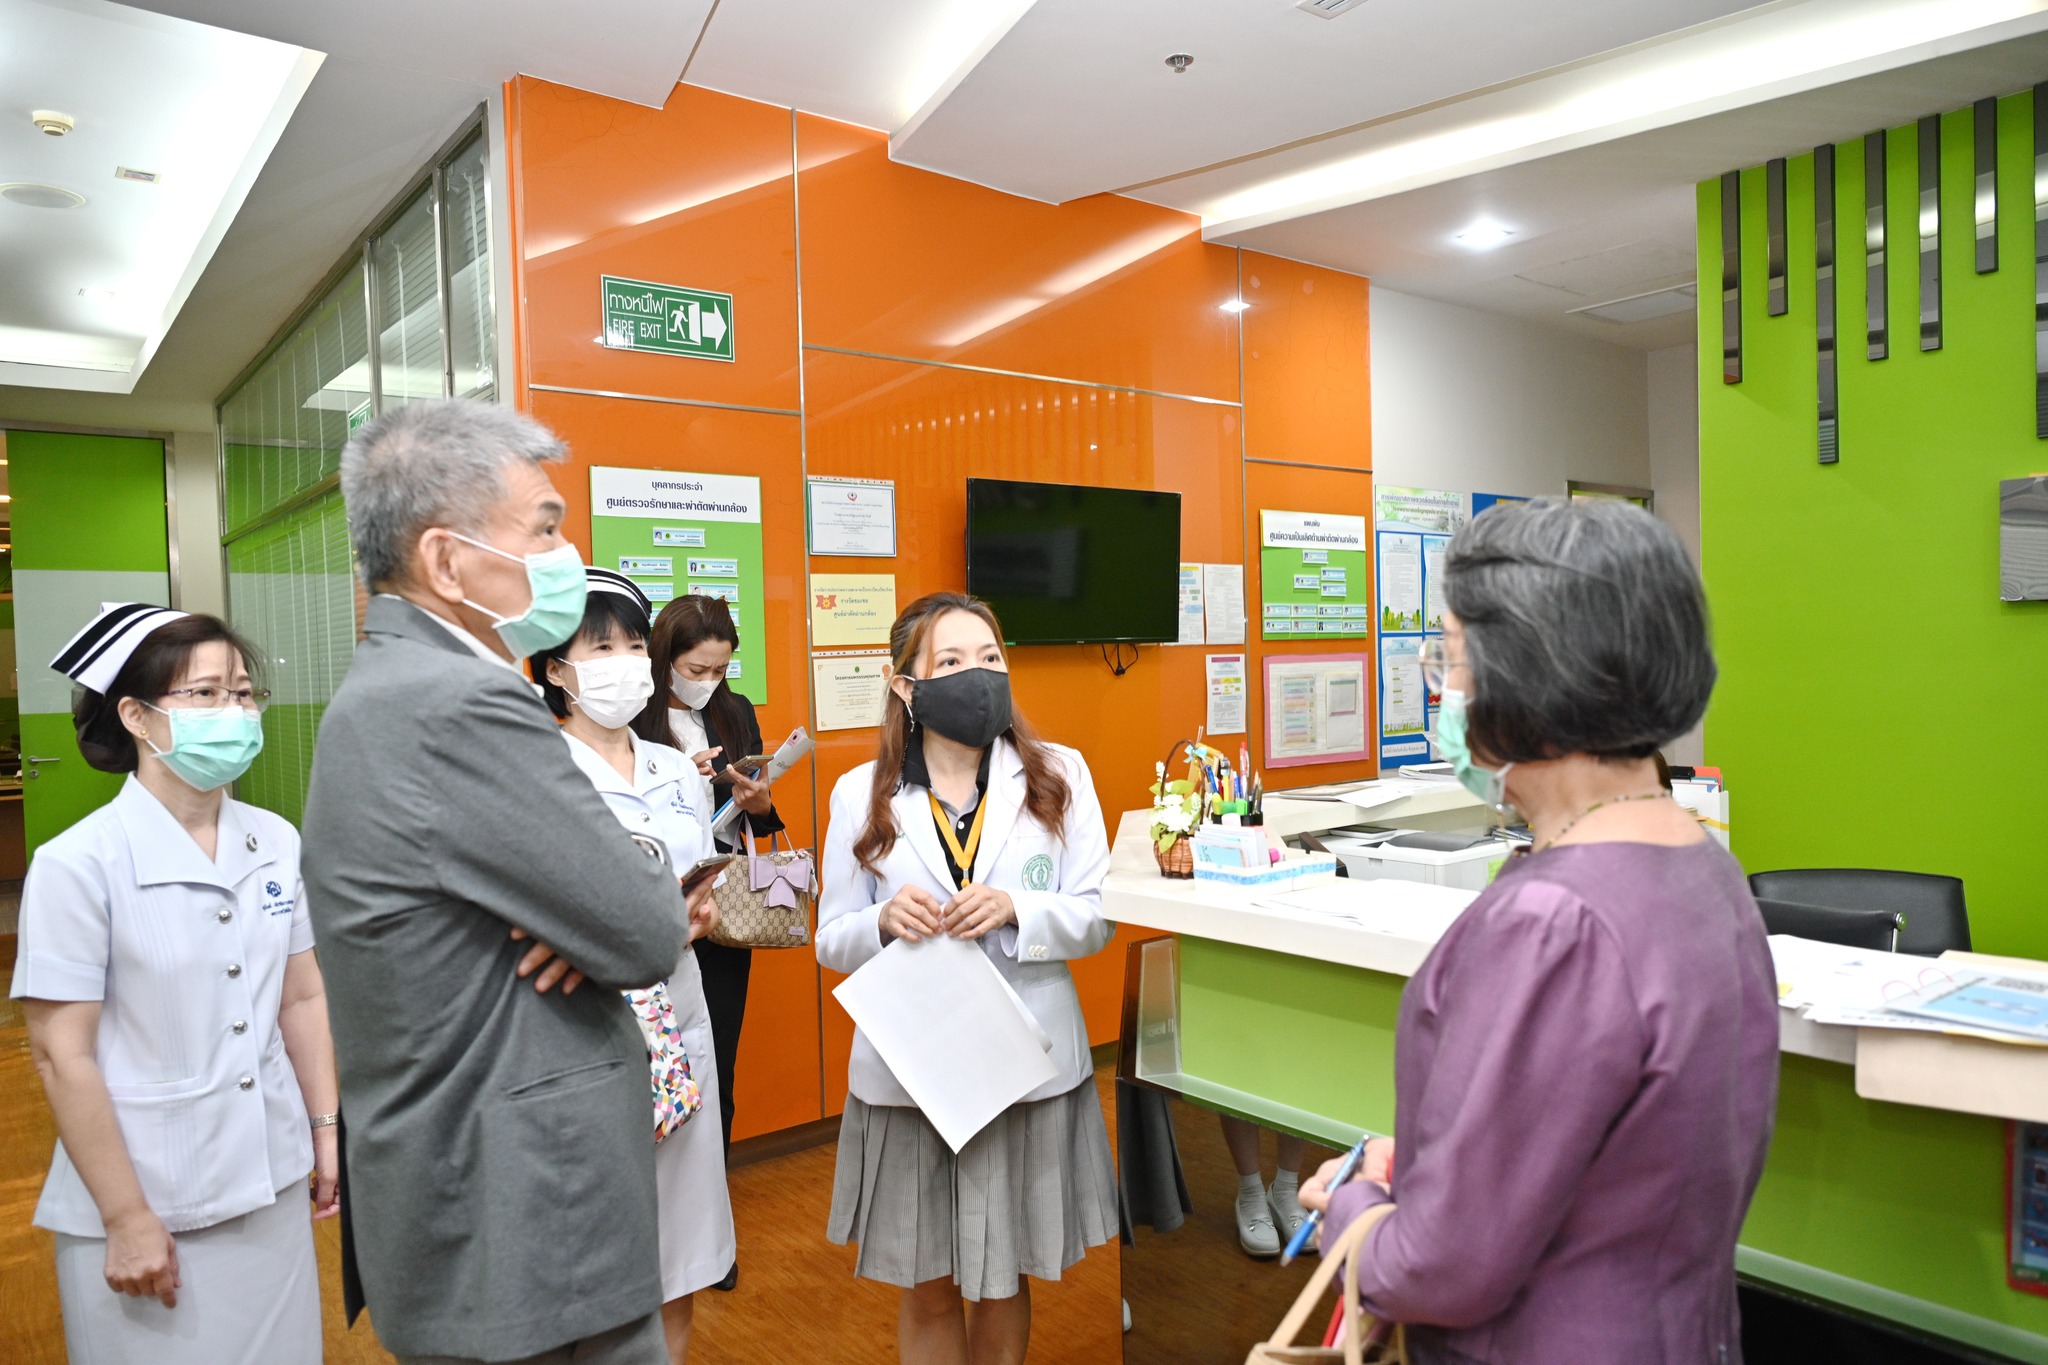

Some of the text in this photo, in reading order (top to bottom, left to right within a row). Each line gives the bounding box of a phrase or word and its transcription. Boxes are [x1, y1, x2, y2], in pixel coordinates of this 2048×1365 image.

[609, 292, 664, 315] ทางหนีไฟ
[613, 318, 661, 339] FIRE EXIT
[651, 481, 703, 491] บุคลากรประจำ
[606, 496, 748, 513] ศูนย์ตรวจรักษาและผ่าตัดผ่านกล้อง
